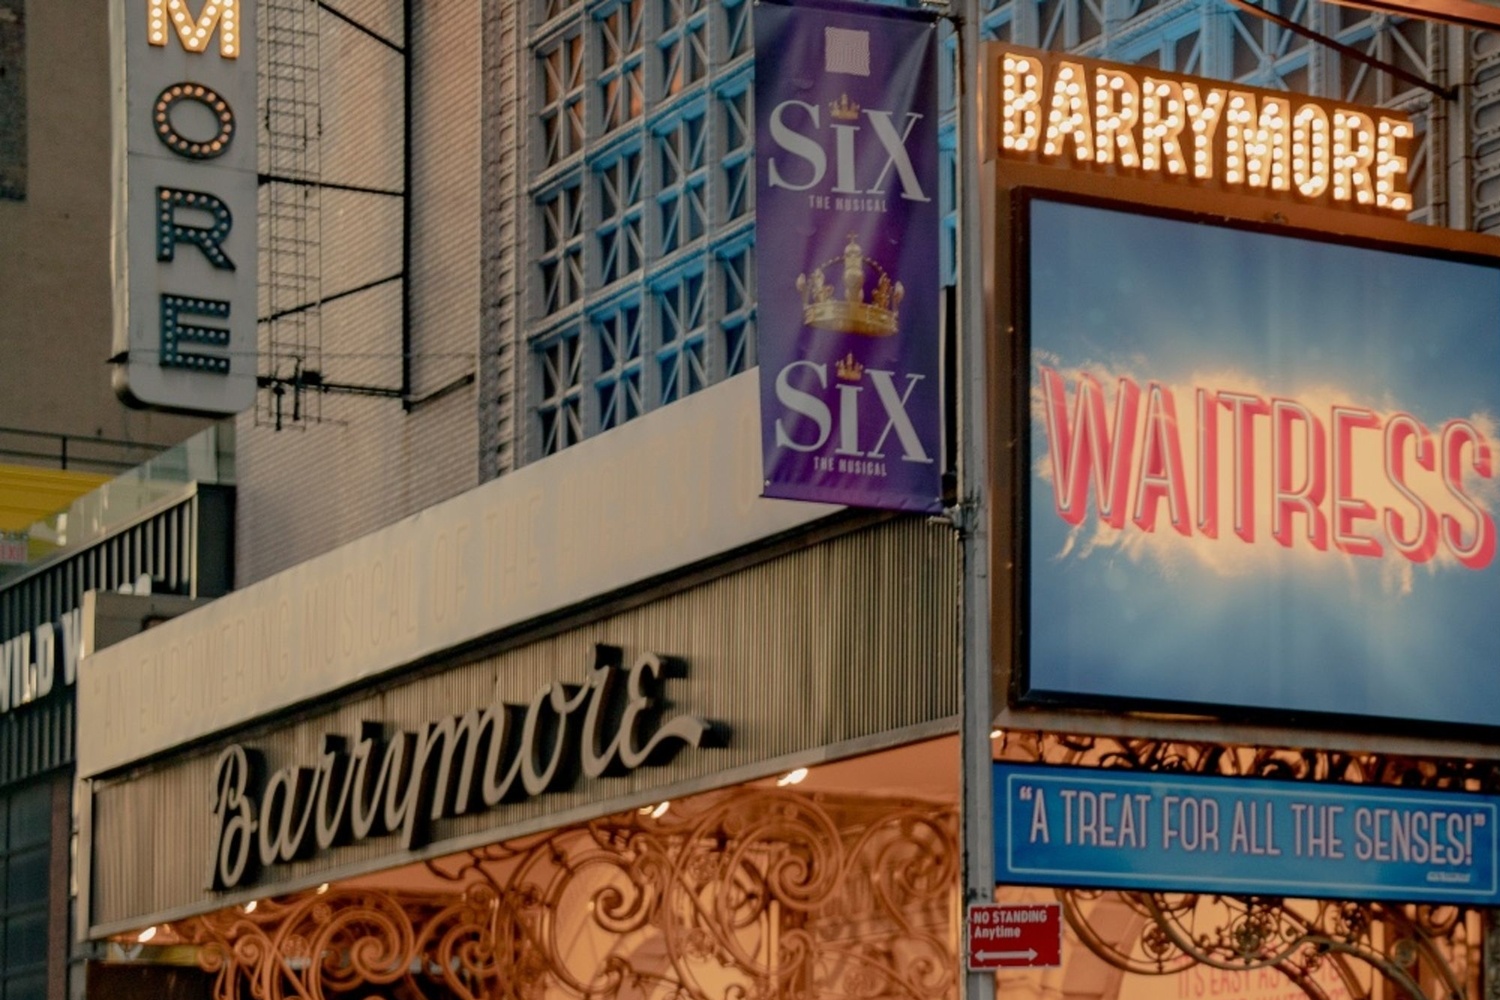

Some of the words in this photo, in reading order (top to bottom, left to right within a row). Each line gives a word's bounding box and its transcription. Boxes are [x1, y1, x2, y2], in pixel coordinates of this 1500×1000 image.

[768, 99, 932, 202] SIX
[1001, 52, 1414, 211] BARRYMORE
[808, 194, 832, 211] THE
[834, 196, 888, 213] MUSICAL
[775, 360, 934, 464] SIX
[813, 456, 834, 472] THE
[837, 458, 888, 477] MUSICAL
[1039, 365, 1497, 570] WAITRESS
[303, 543, 417, 670] MUSICAL
[482, 488, 541, 612] THE
[210, 643, 713, 890] Barrymore
[1019, 785, 1050, 845] “A
[1060, 789, 1151, 850] TREAT
[1163, 795, 1219, 853] FOR
[1231, 800, 1281, 857] ALL
[1291, 803, 1344, 860] THE
[1355, 806, 1486, 867] SENSES!”
[973, 910, 990, 925] NO
[992, 909, 1048, 924] STANDING
[974, 925, 1021, 941] Anytime
